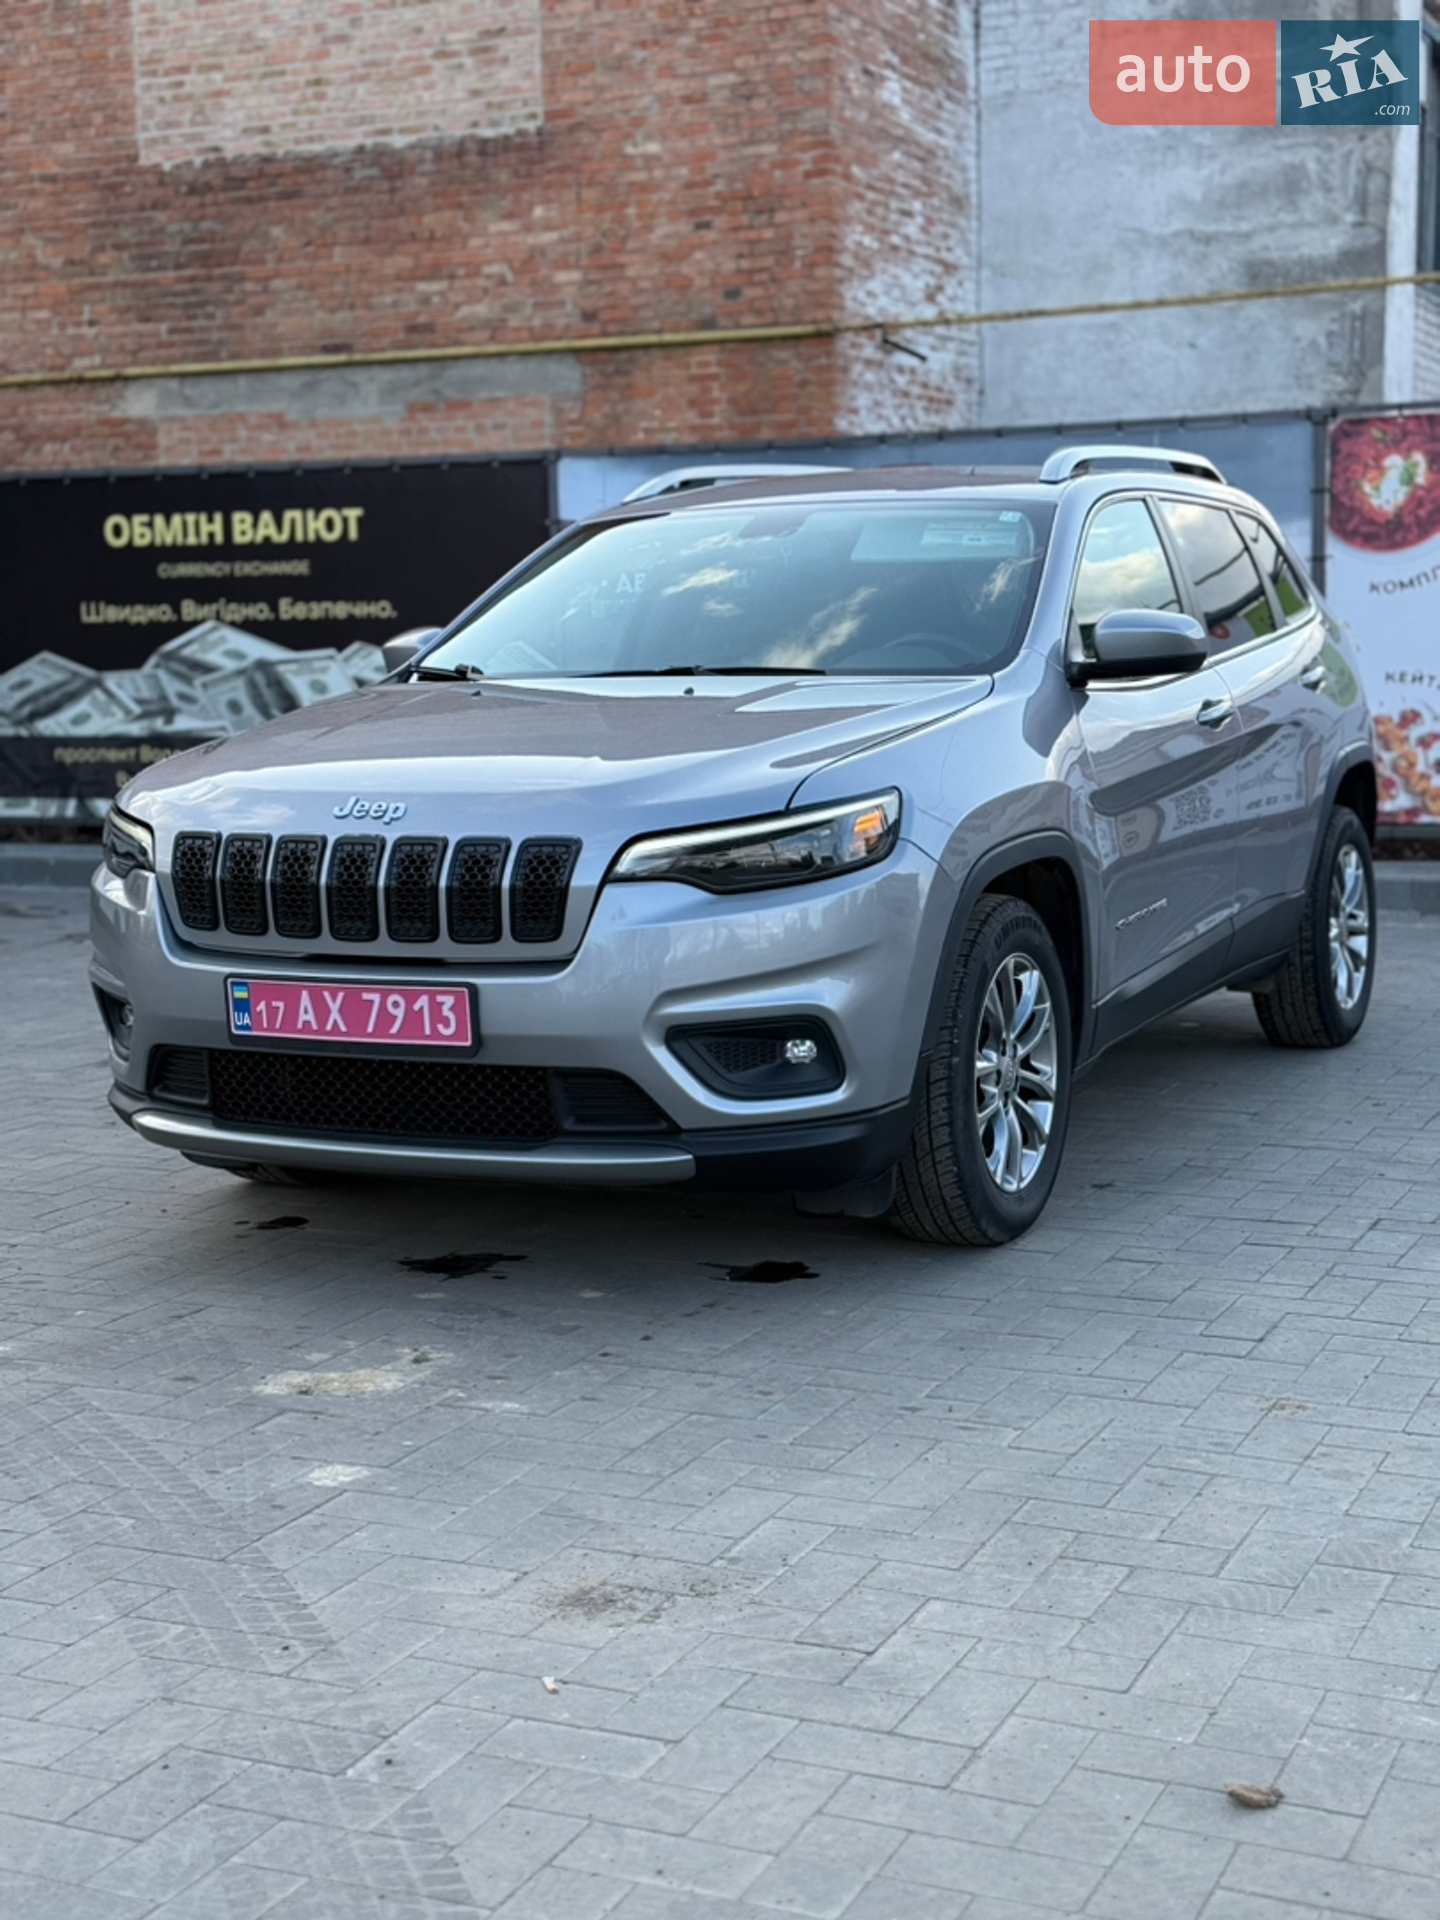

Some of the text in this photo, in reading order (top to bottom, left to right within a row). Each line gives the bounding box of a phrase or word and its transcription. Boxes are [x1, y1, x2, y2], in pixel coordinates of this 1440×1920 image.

[103, 506, 364, 548] ОБМІН ВАЛЮТ
[80, 596, 398, 625] Швидко. Вигідно. Безпечно.
[332, 795, 407, 826] Jeep
[234, 1011, 252, 1027] UA
[256, 989, 457, 1037] 17 AX 7913
